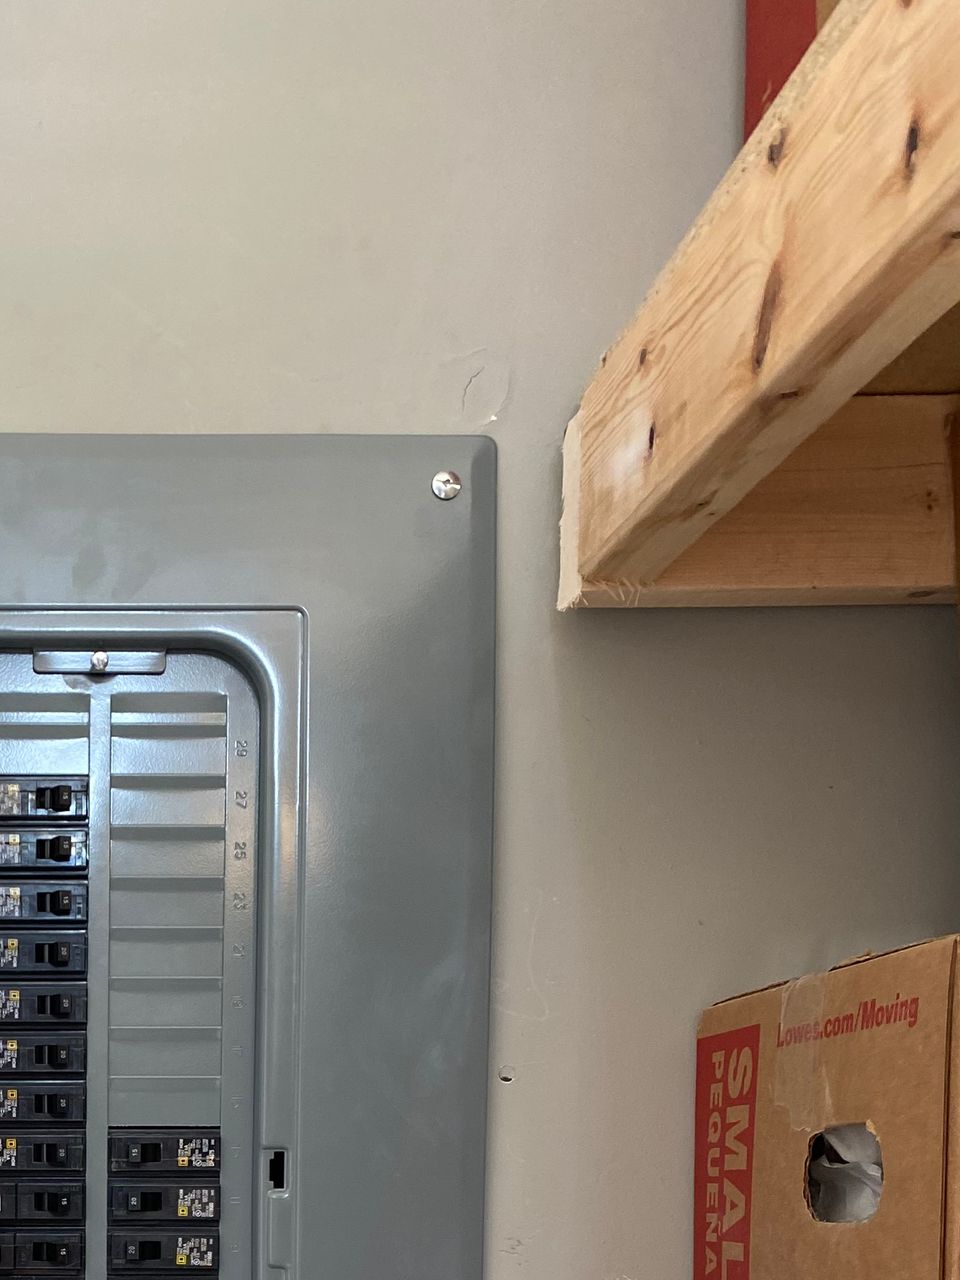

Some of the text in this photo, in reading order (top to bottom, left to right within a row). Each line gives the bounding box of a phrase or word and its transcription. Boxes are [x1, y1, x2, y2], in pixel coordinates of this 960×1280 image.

[234, 740, 248, 757] 29
[234, 791, 248, 809] 27
[234, 841, 247, 861] 25
[63, 896, 69, 904] 15
[61, 947, 67, 956] 20
[63, 999, 69, 1007] 20
[776, 993, 920, 1048] Lowes.com/Moving
[60, 1050, 66, 1059] 20
[60, 1099, 66, 1107] 20
[59, 1148, 65, 1157] 20
[132, 1148, 138, 1156] 15
[704, 1050, 725, 1275] PEQUEÑA
[131, 1197, 137, 1206] 20
[60, 1248, 66, 1256] 15
[129, 1245, 135, 1254] 20
